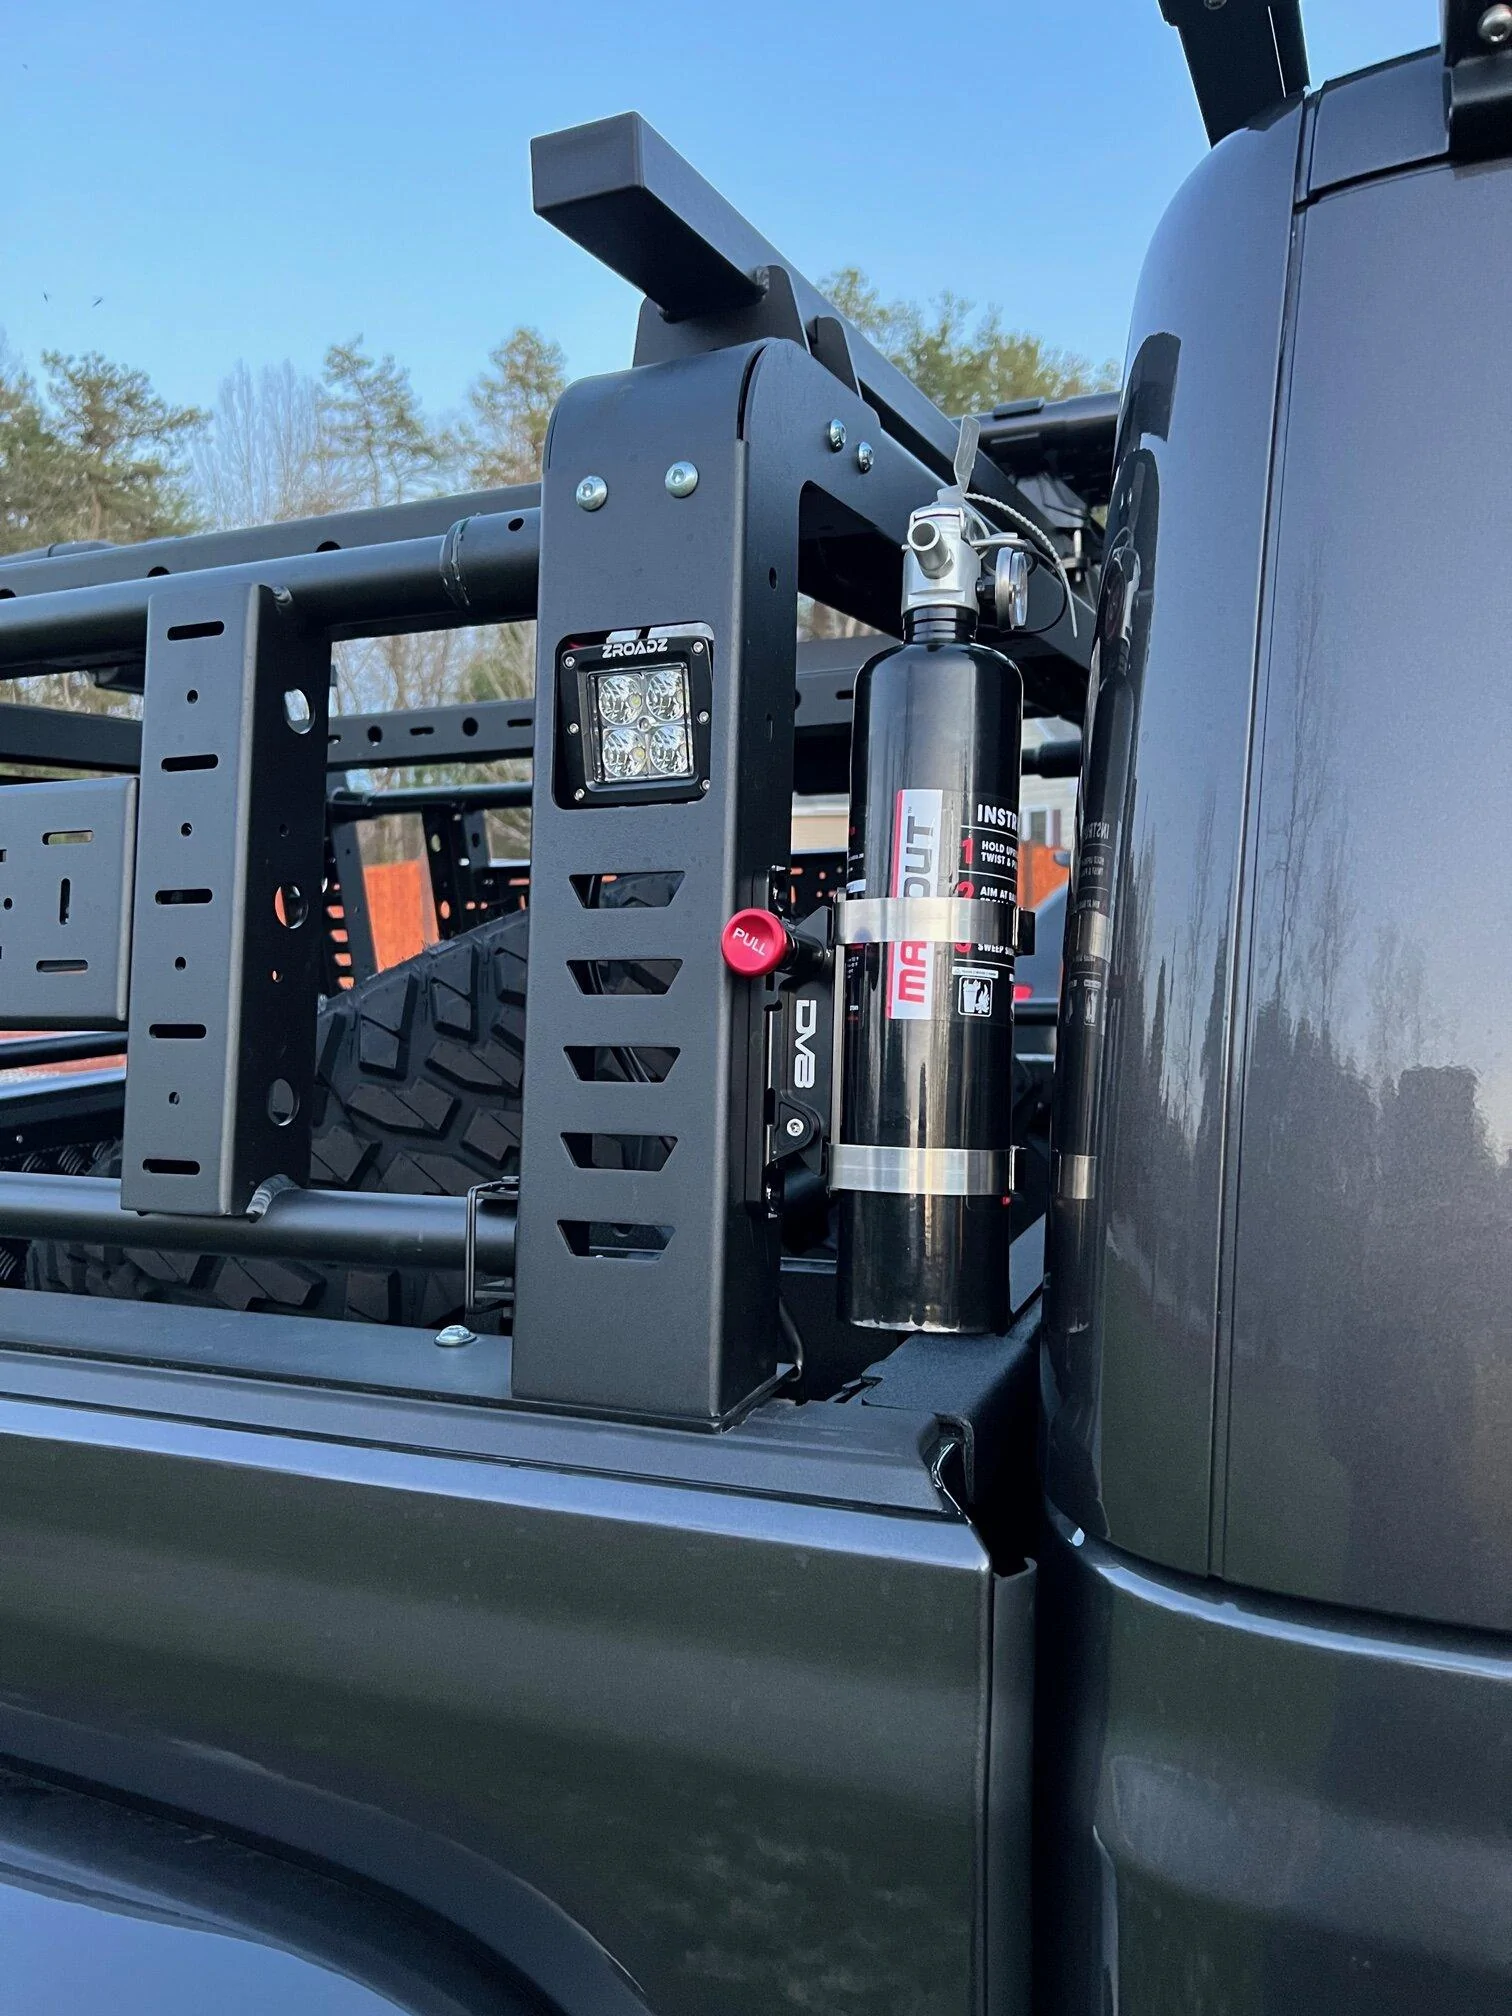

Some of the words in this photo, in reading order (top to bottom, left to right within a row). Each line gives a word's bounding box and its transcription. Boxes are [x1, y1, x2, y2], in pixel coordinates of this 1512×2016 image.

[602, 638, 668, 658] ZROADZ
[962, 838, 974, 865] 1
[981, 841, 1005, 853] HOLD
[981, 852, 1006, 865] TWIST
[980, 886, 998, 897] AIM
[999, 890, 1008, 900] AT
[898, 815, 934, 1003] MAOUT
[732, 927, 767, 956] PULL
[794, 1000, 817, 1089] DV8
